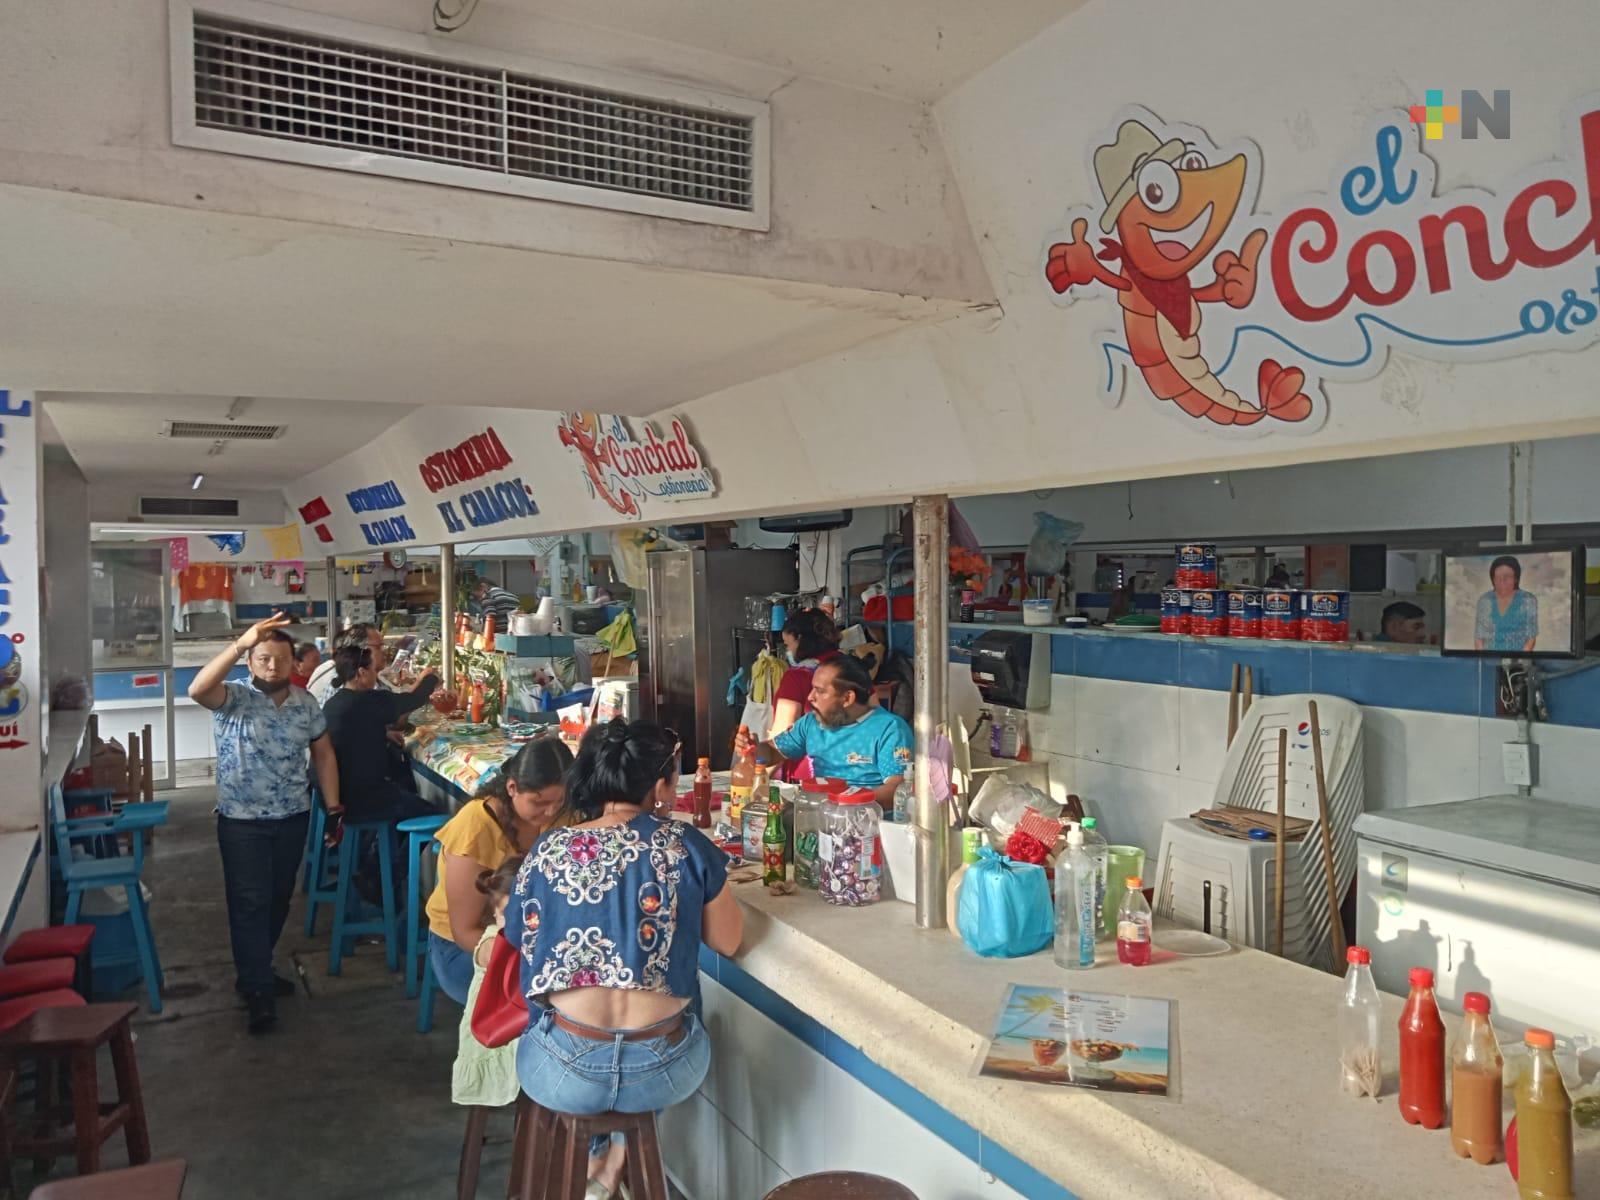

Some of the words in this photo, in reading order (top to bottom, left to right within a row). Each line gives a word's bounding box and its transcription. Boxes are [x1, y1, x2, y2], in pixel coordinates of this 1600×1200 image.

[1341, 125, 1418, 216] el
[607, 420, 699, 478] Conchal
[611, 415, 628, 443] el
